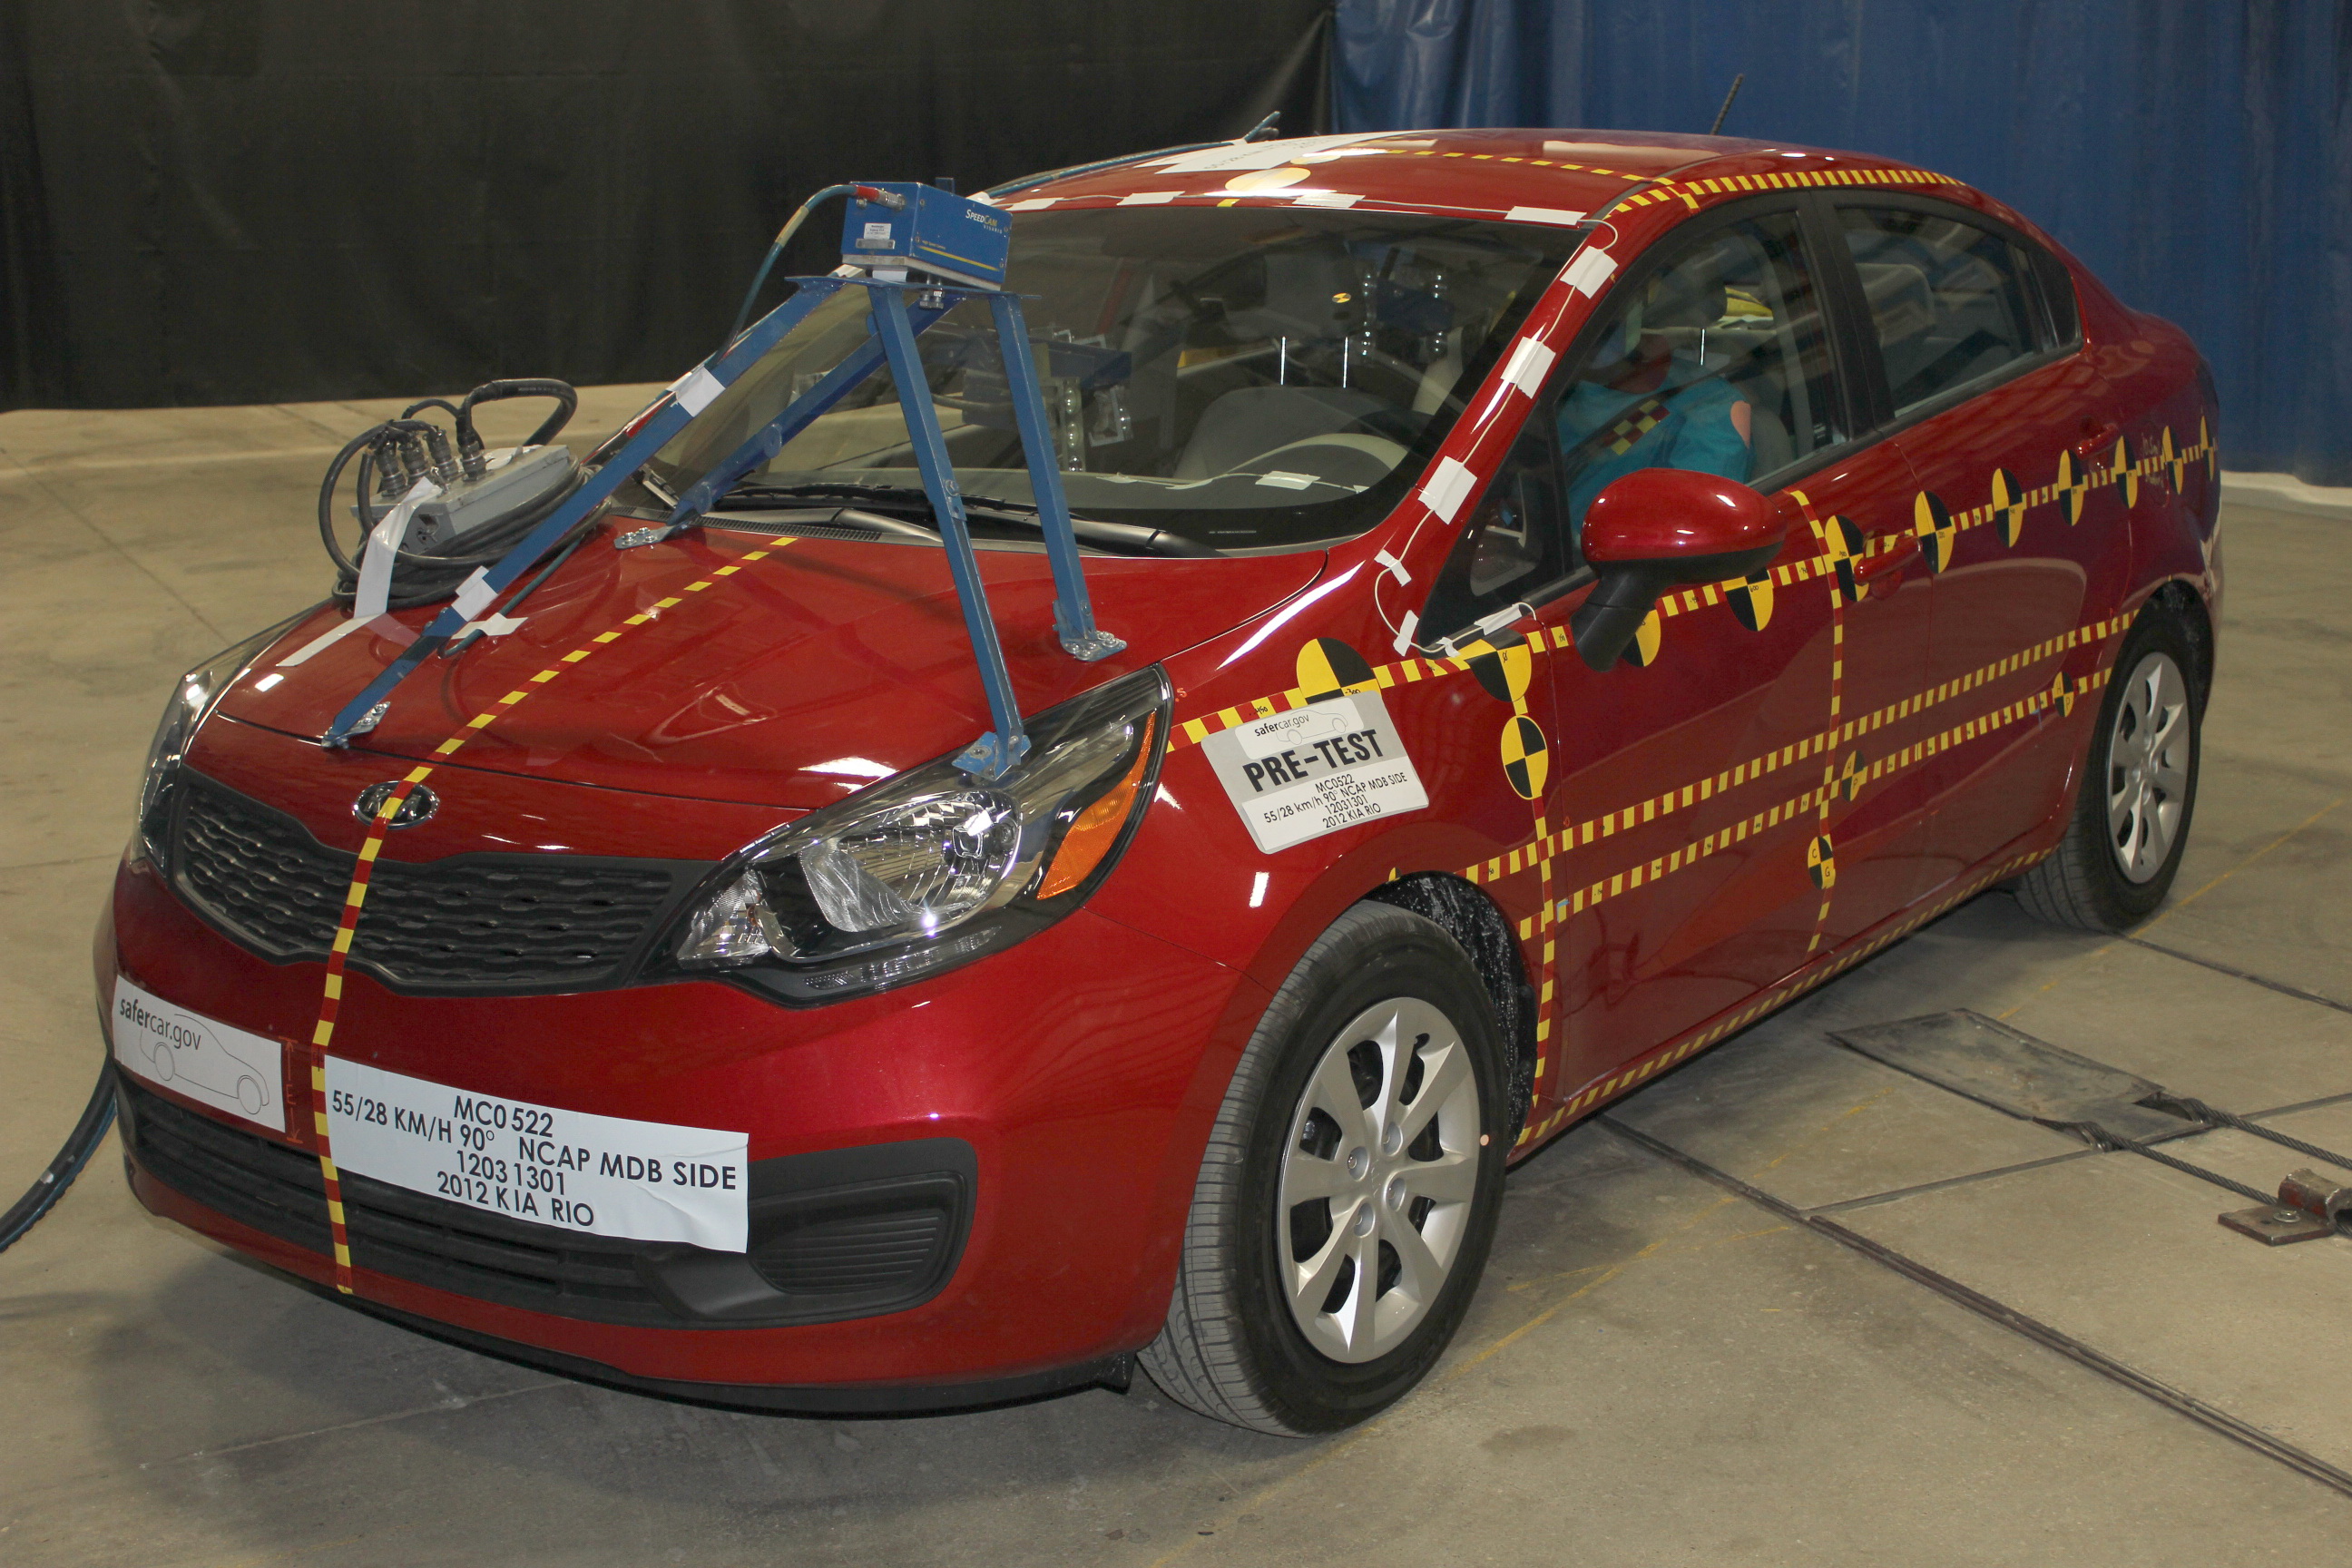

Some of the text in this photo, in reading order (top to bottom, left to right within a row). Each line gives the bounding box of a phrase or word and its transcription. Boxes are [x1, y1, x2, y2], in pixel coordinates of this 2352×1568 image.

[1254, 713, 1310, 737] safercar.gov
[1242, 729, 1384, 793] PRE-TEST
[363, 787, 422, 820] KA
[1263, 772, 1408, 823] 55/28 km/h 90° NCAP MDB SIDE
[1315, 774, 1356, 793] MC0522
[1322, 803, 1381, 828] 2012 KIA RIO
[1325, 795, 1368, 815] 12031301
[120, 998, 201, 1051] safercar.gov
[331, 1090, 737, 1191] 55/28 KM/H 90° NCAP MDB SIDE
[436, 1171, 595, 1228] 2012 KIA RIO
